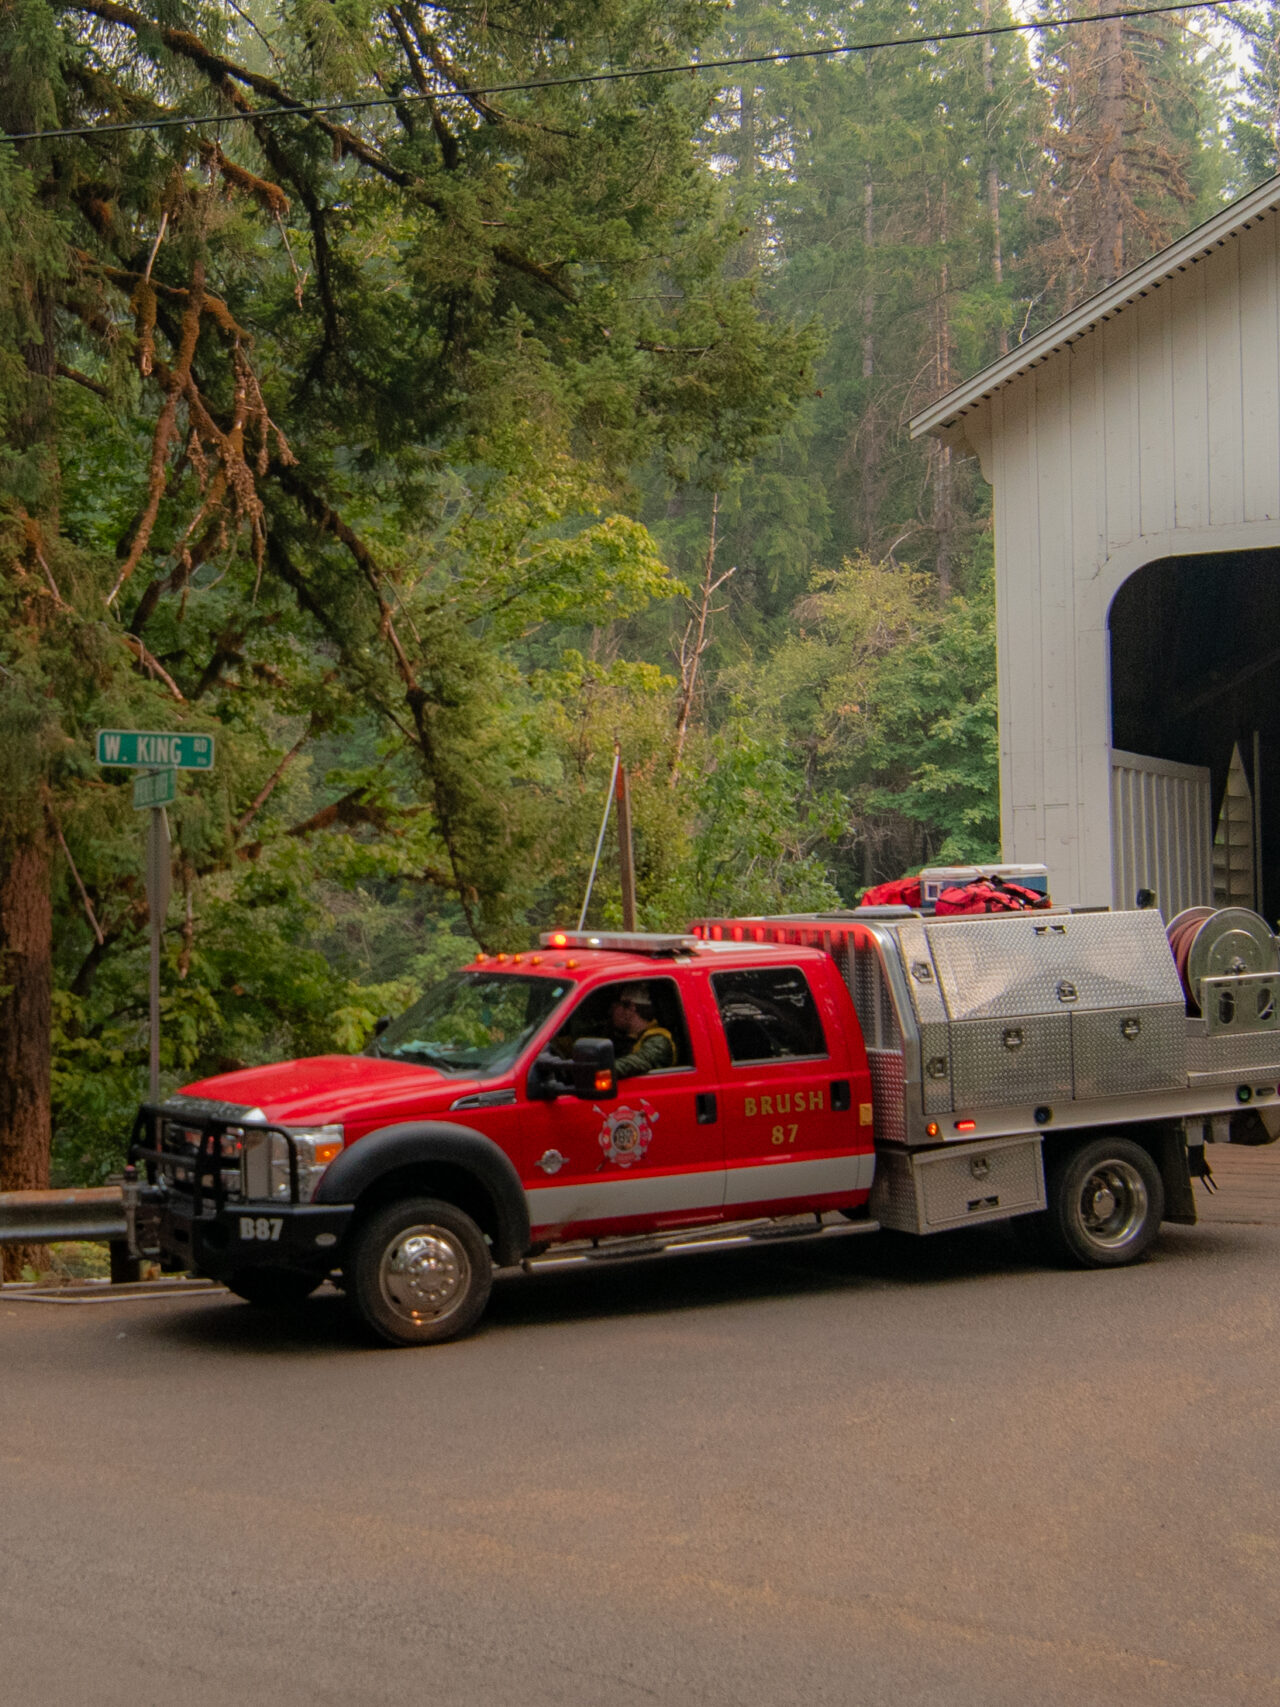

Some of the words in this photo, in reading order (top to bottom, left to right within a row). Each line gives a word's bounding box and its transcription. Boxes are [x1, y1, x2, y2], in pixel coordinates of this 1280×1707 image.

[103, 734, 128, 762] W.
[136, 735, 182, 764] KING
[744, 1091, 824, 1117] BRUSH
[771, 1124, 799, 1145] 87
[239, 1217, 284, 1241] B87
